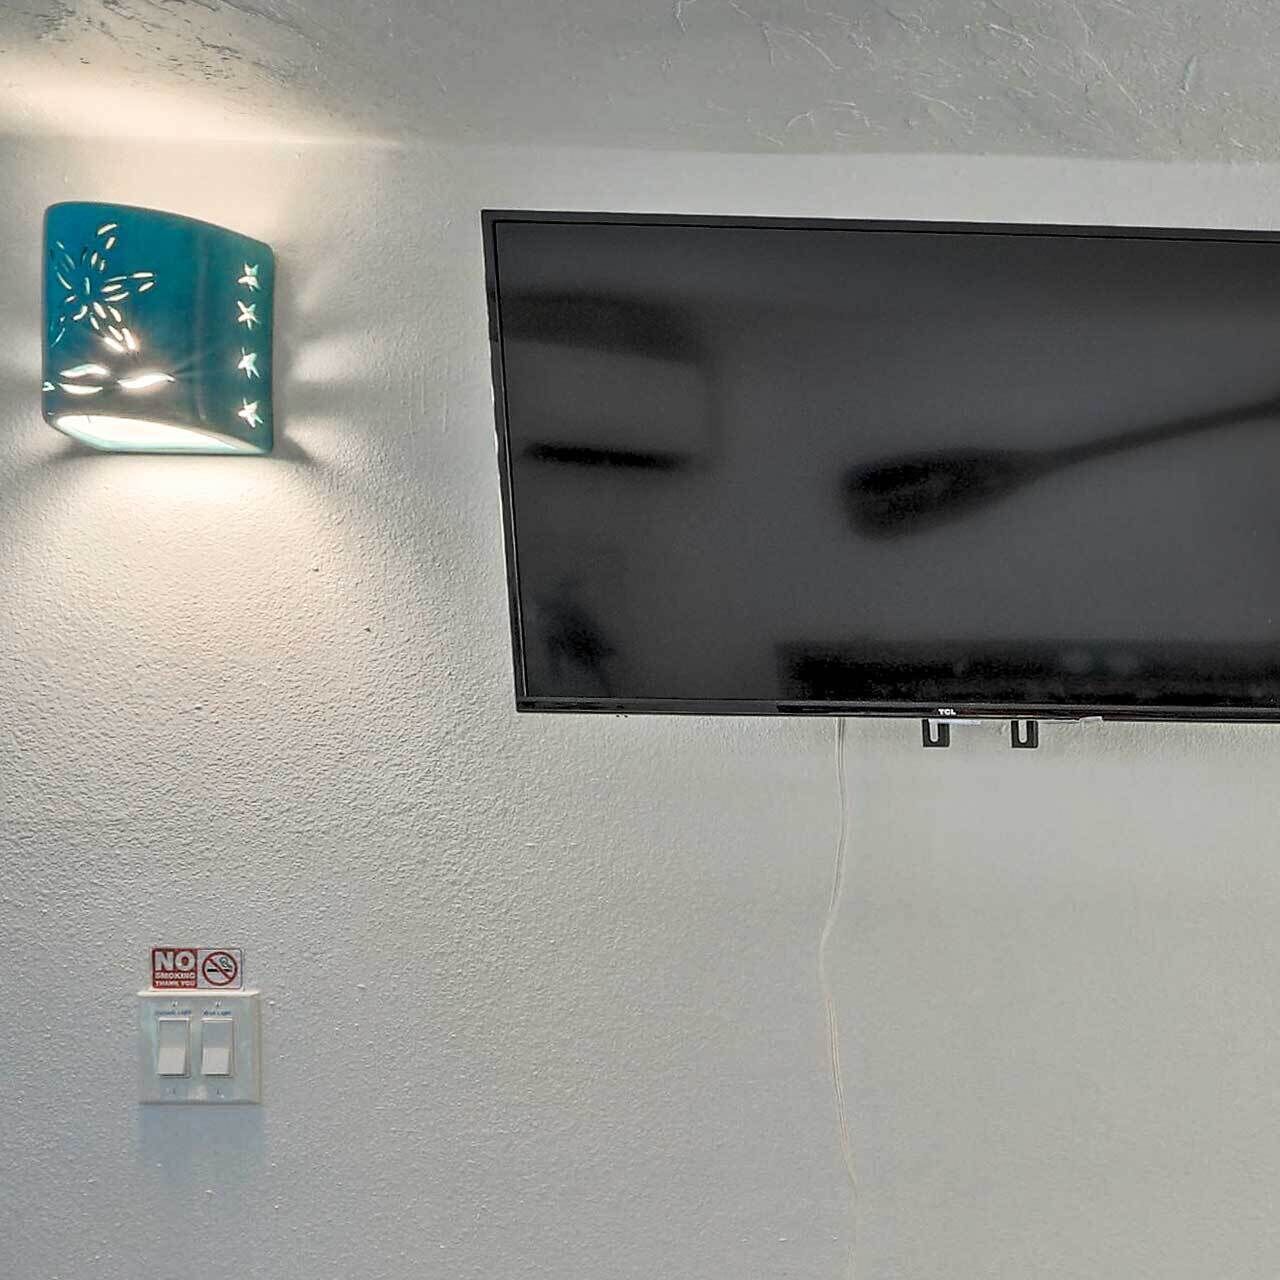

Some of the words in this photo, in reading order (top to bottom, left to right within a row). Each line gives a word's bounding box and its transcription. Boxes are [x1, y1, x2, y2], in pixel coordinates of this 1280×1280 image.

[938, 708, 957, 716] TCL
[154, 951, 196, 971] NO
[154, 971, 196, 980] SMOKING
